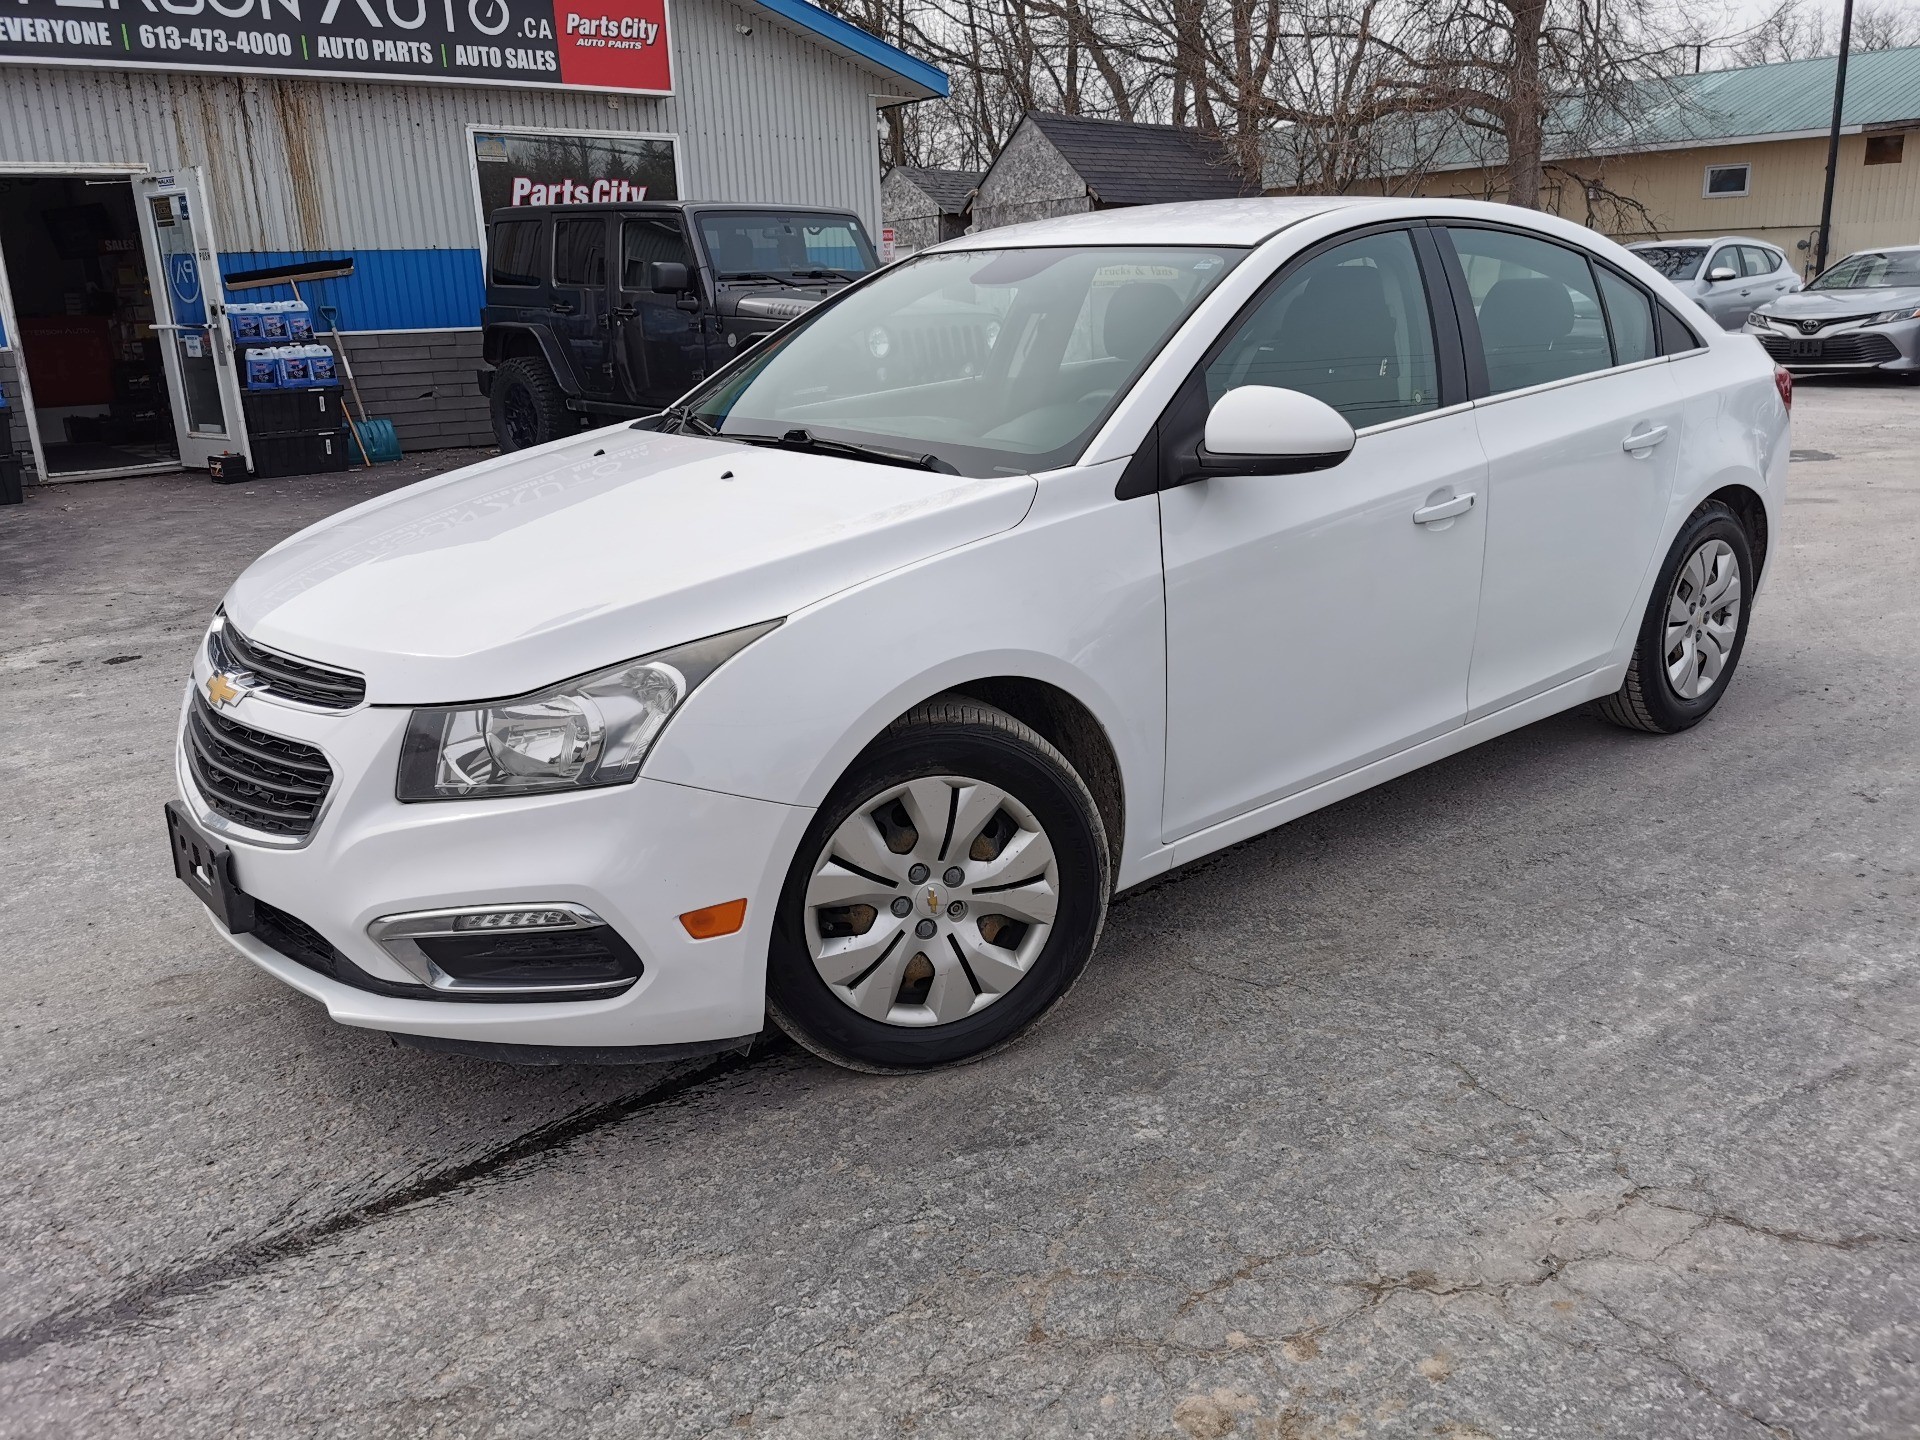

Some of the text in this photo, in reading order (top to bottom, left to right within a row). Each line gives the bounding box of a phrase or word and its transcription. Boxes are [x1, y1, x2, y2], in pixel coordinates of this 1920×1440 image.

[139, 24, 292, 56] 613-473-4000
[317, 36, 433, 64] AUTO PARTS
[576, 37, 642, 50] AUTO PARTS
[455, 44, 557, 72] AUTO SALES
[104, 240, 135, 251] SALES
[766, 303, 807, 316] WILLY
